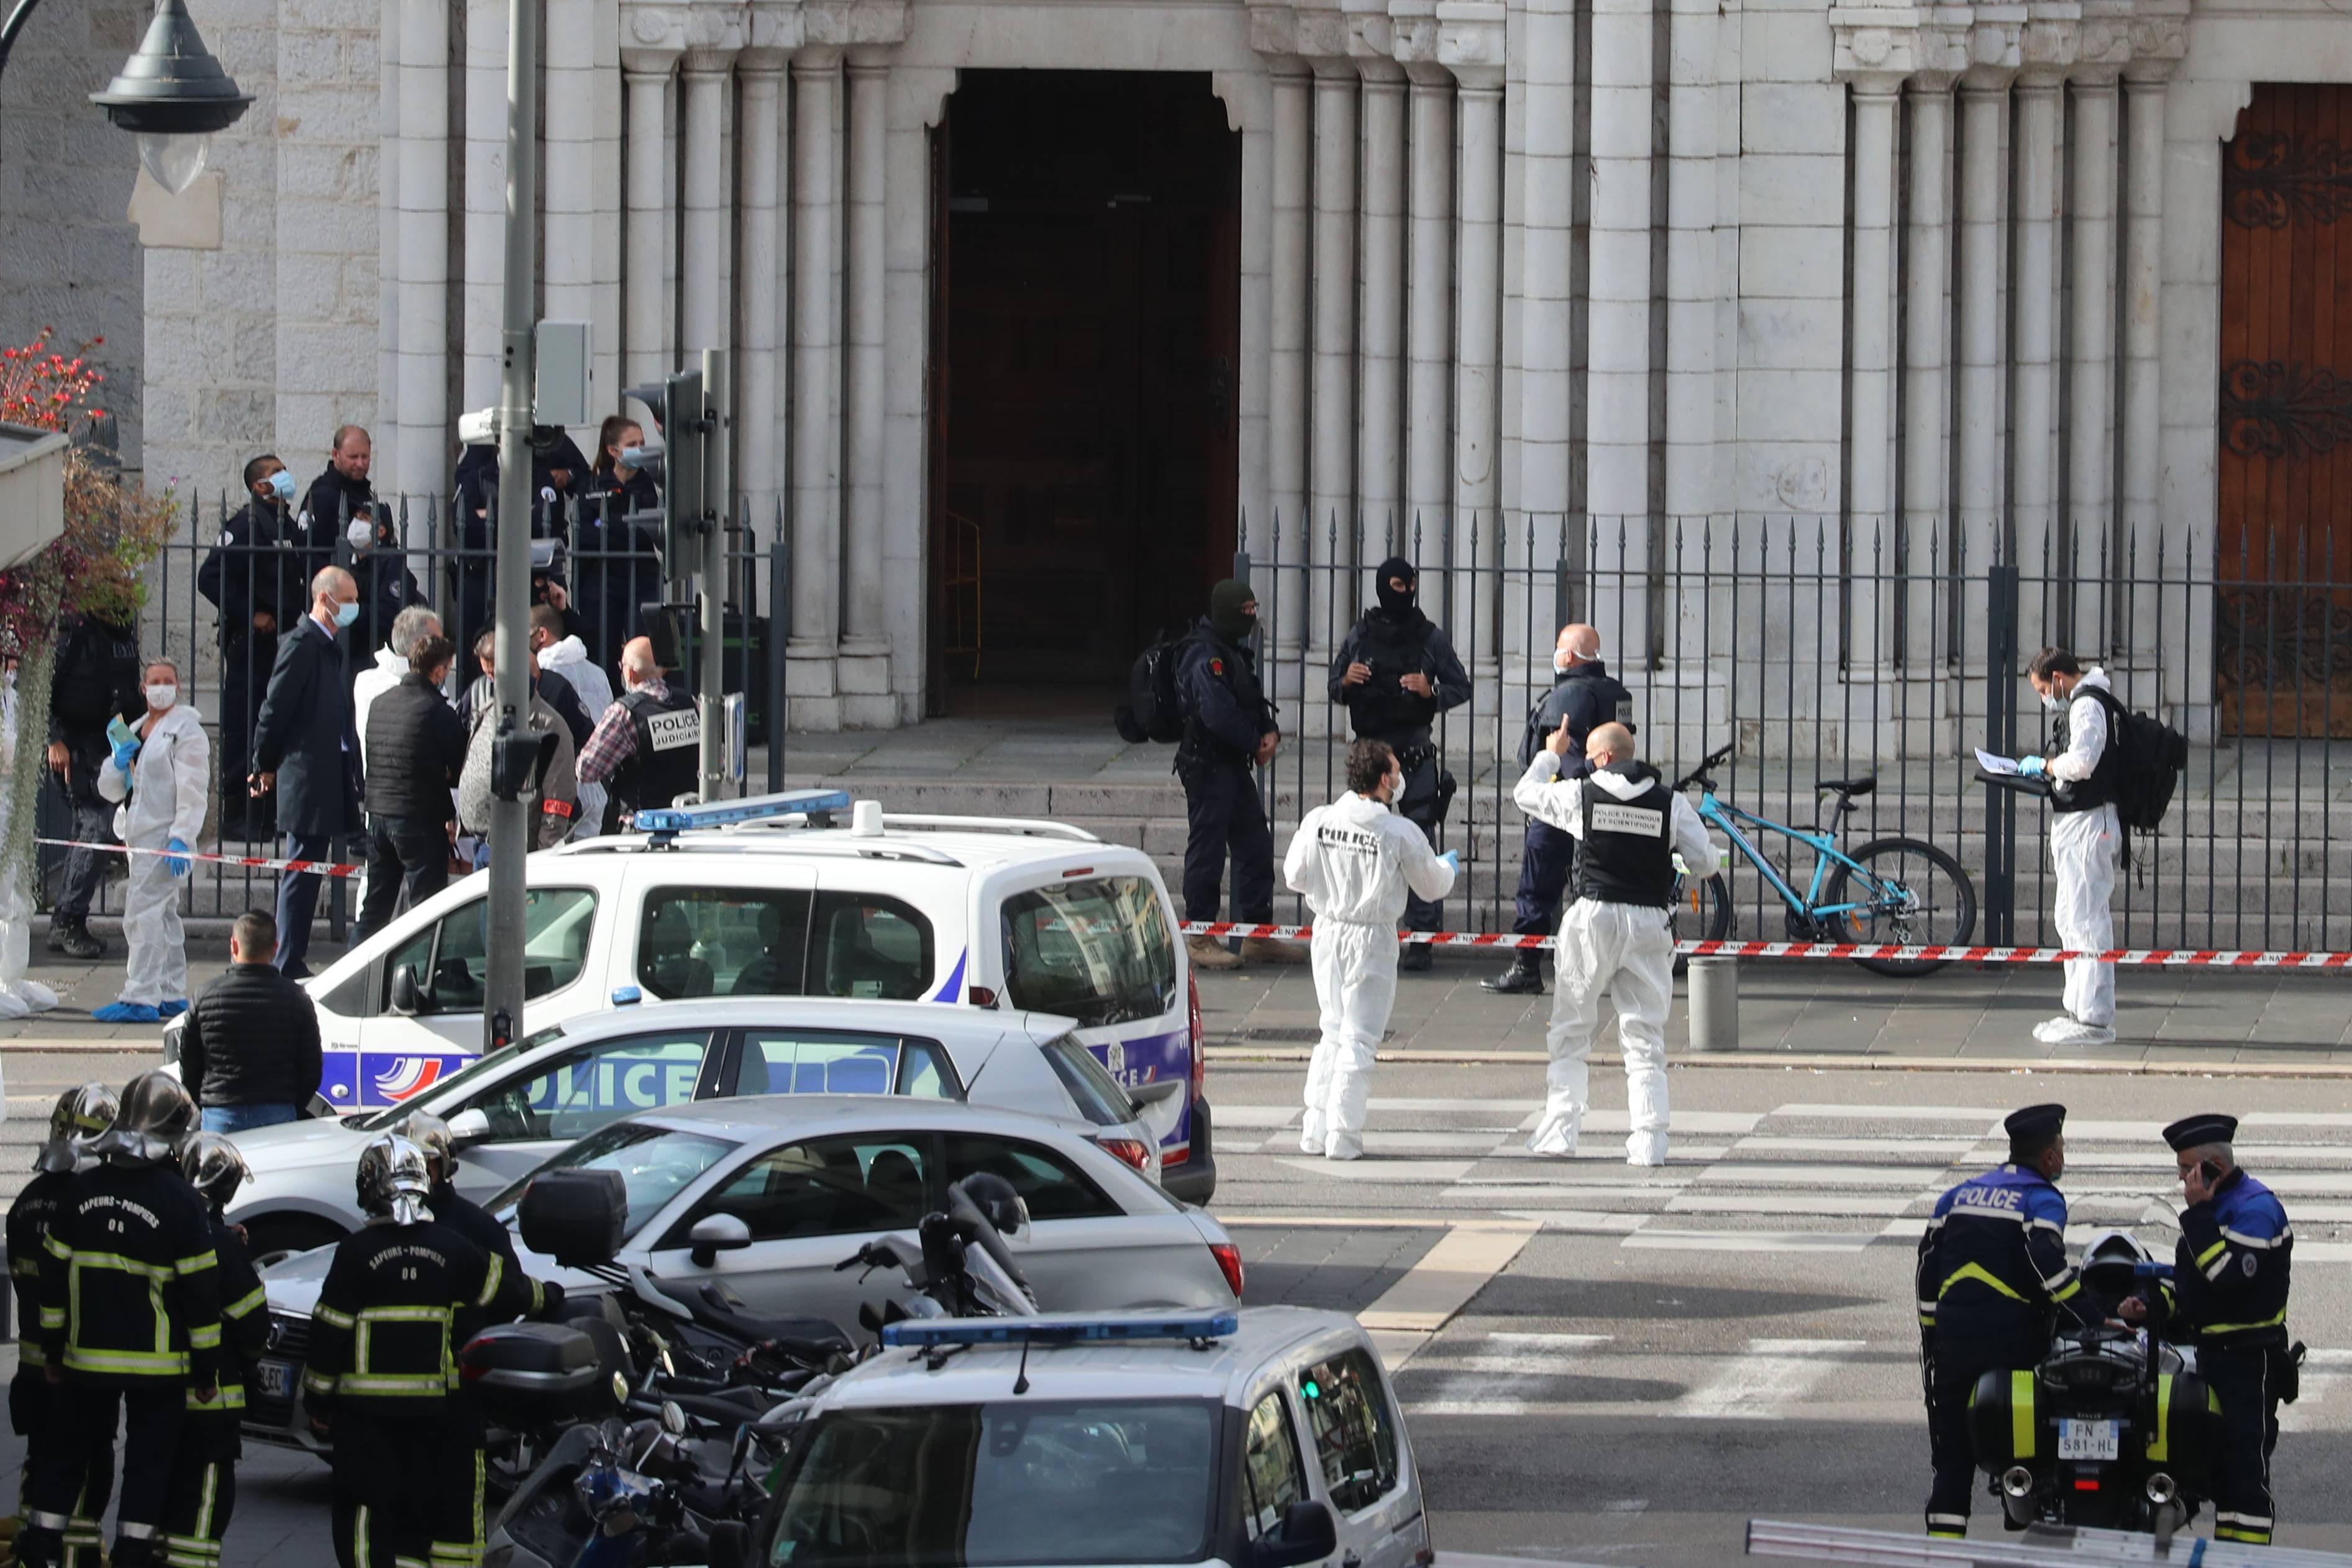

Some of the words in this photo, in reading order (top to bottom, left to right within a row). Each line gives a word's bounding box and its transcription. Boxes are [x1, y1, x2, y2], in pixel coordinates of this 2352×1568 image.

[652, 714, 700, 734] POLICE
[655, 730, 700, 745] JUDICIAIR
[1594, 809, 1620, 818] POLICE
[1622, 811, 1661, 823] TECHNIQUE
[1608, 819, 1656, 830] SCIENTIFIQUE
[1197, 924, 1241, 932] NATIONALE
[1254, 926, 1282, 934] POLICE
[1462, 934, 1508, 943] NATIONALE
[1819, 946, 1864, 954] NATIONALE
[2088, 952, 2133, 960] NATIONALE
[2269, 954, 2314, 963] NATIONALE
[527, 1063, 698, 1106] LICE
[1953, 1186, 2023, 1211] POLICE
